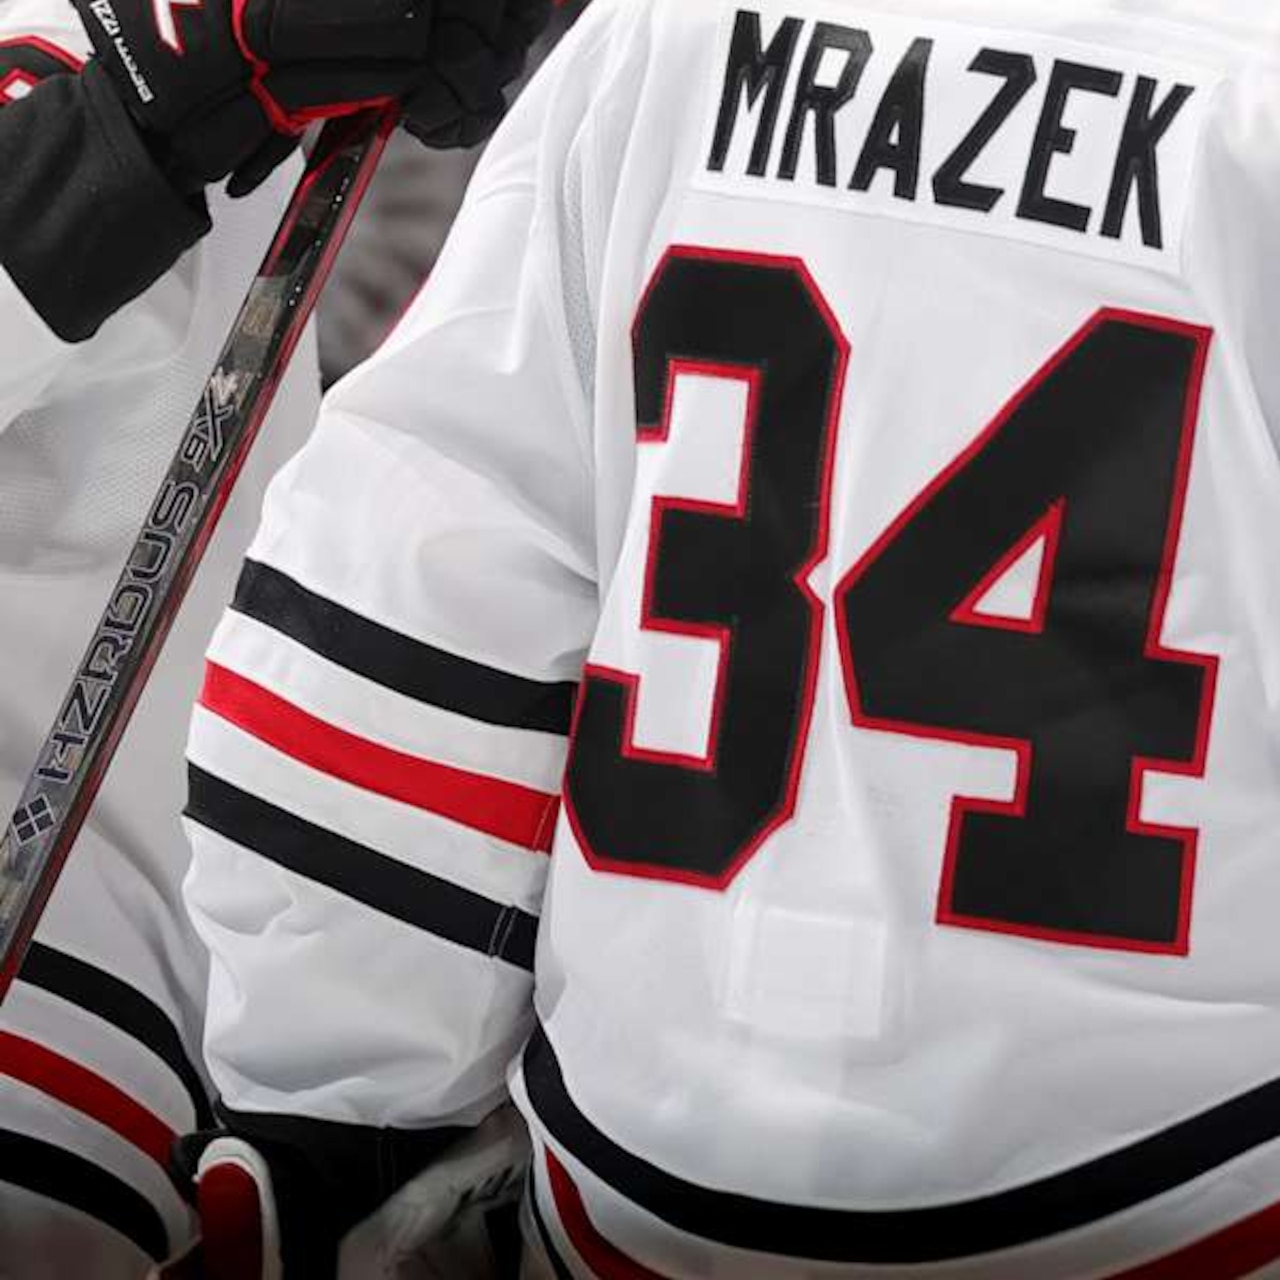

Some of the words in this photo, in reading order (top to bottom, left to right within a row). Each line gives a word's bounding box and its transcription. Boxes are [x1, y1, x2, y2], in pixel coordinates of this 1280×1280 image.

[706, 8, 1194, 250] MRAZEK
[36, 479, 200, 786] HZRDUS
[561, 245, 1218, 956] 34
